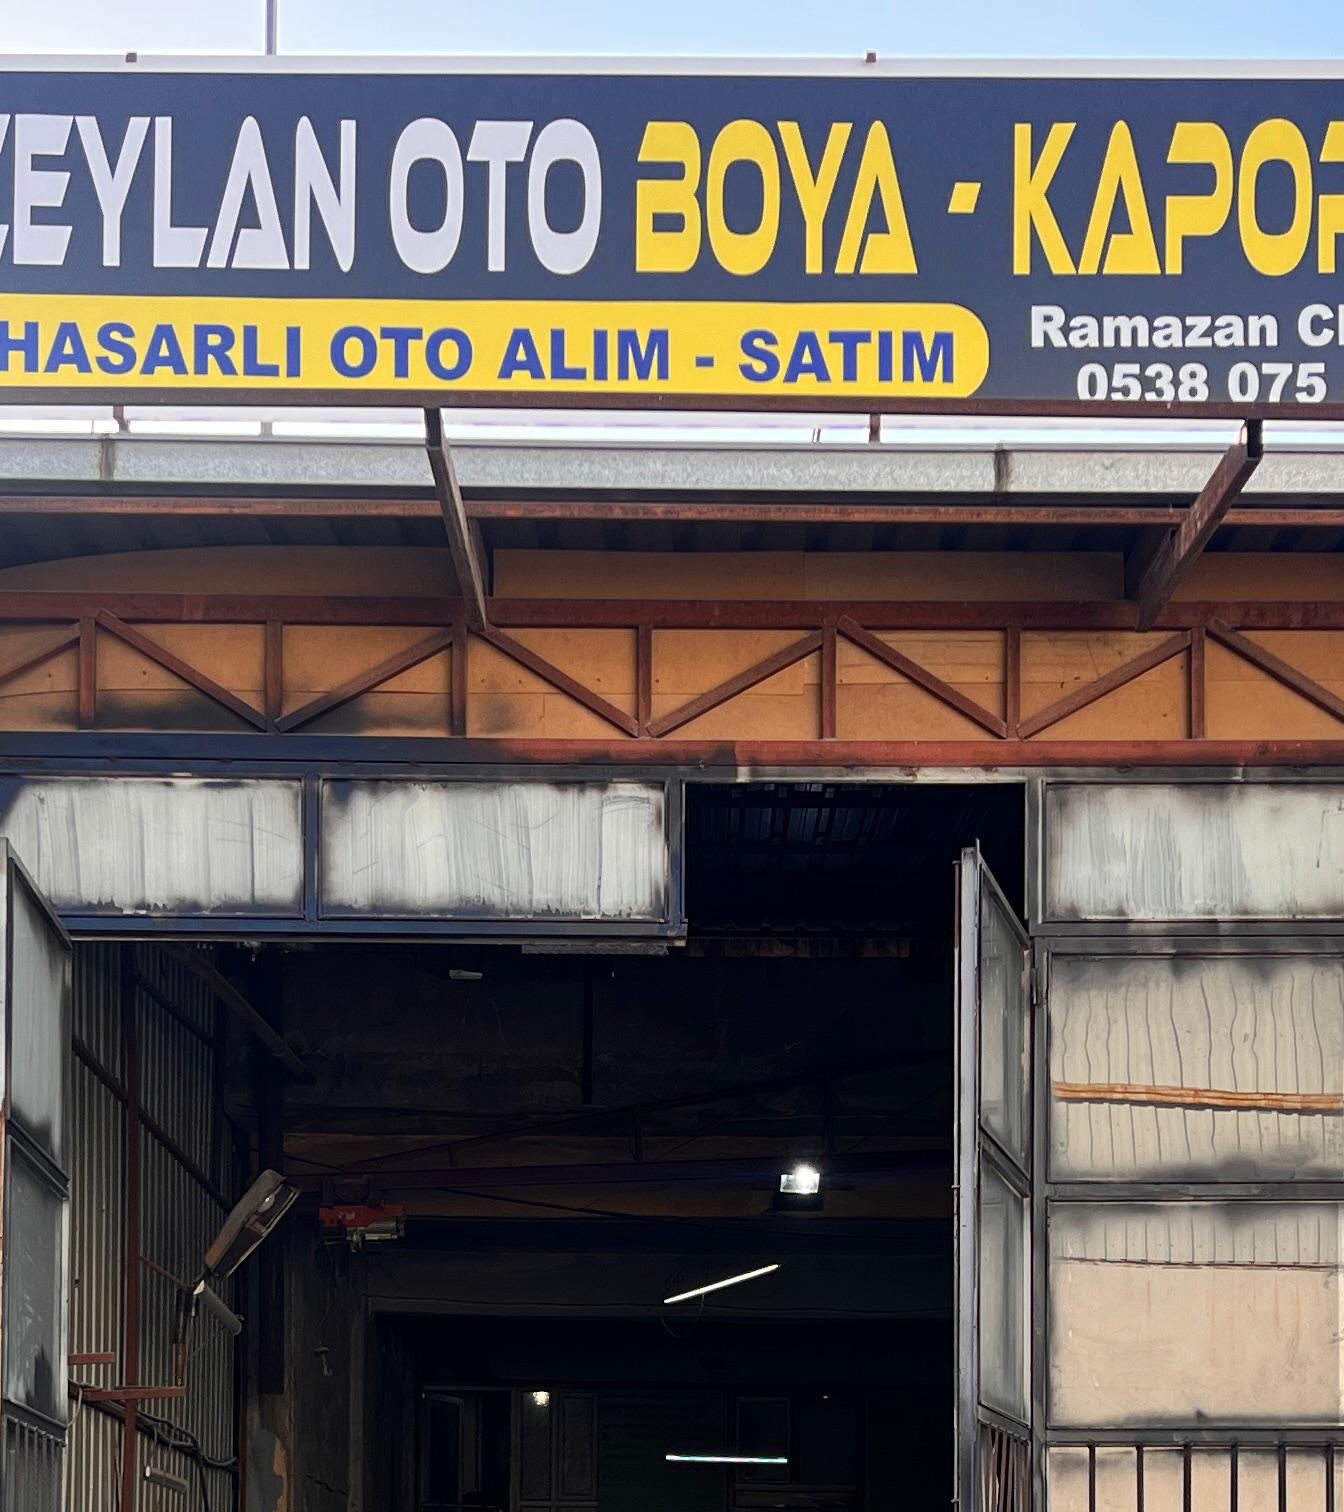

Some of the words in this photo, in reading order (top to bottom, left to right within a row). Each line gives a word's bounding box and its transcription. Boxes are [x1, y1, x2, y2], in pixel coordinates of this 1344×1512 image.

[389, 117, 603, 276] OTO
[635, 119, 918, 276] BOYA
[1030, 304, 1280, 348] Ramazan
[329, 326, 474, 381] OTO
[498, 328, 670, 382] ALIM
[738, 329, 955, 384] SATIM
[1076, 362, 1210, 402] 0538
[1227, 361, 1327, 404] 075
